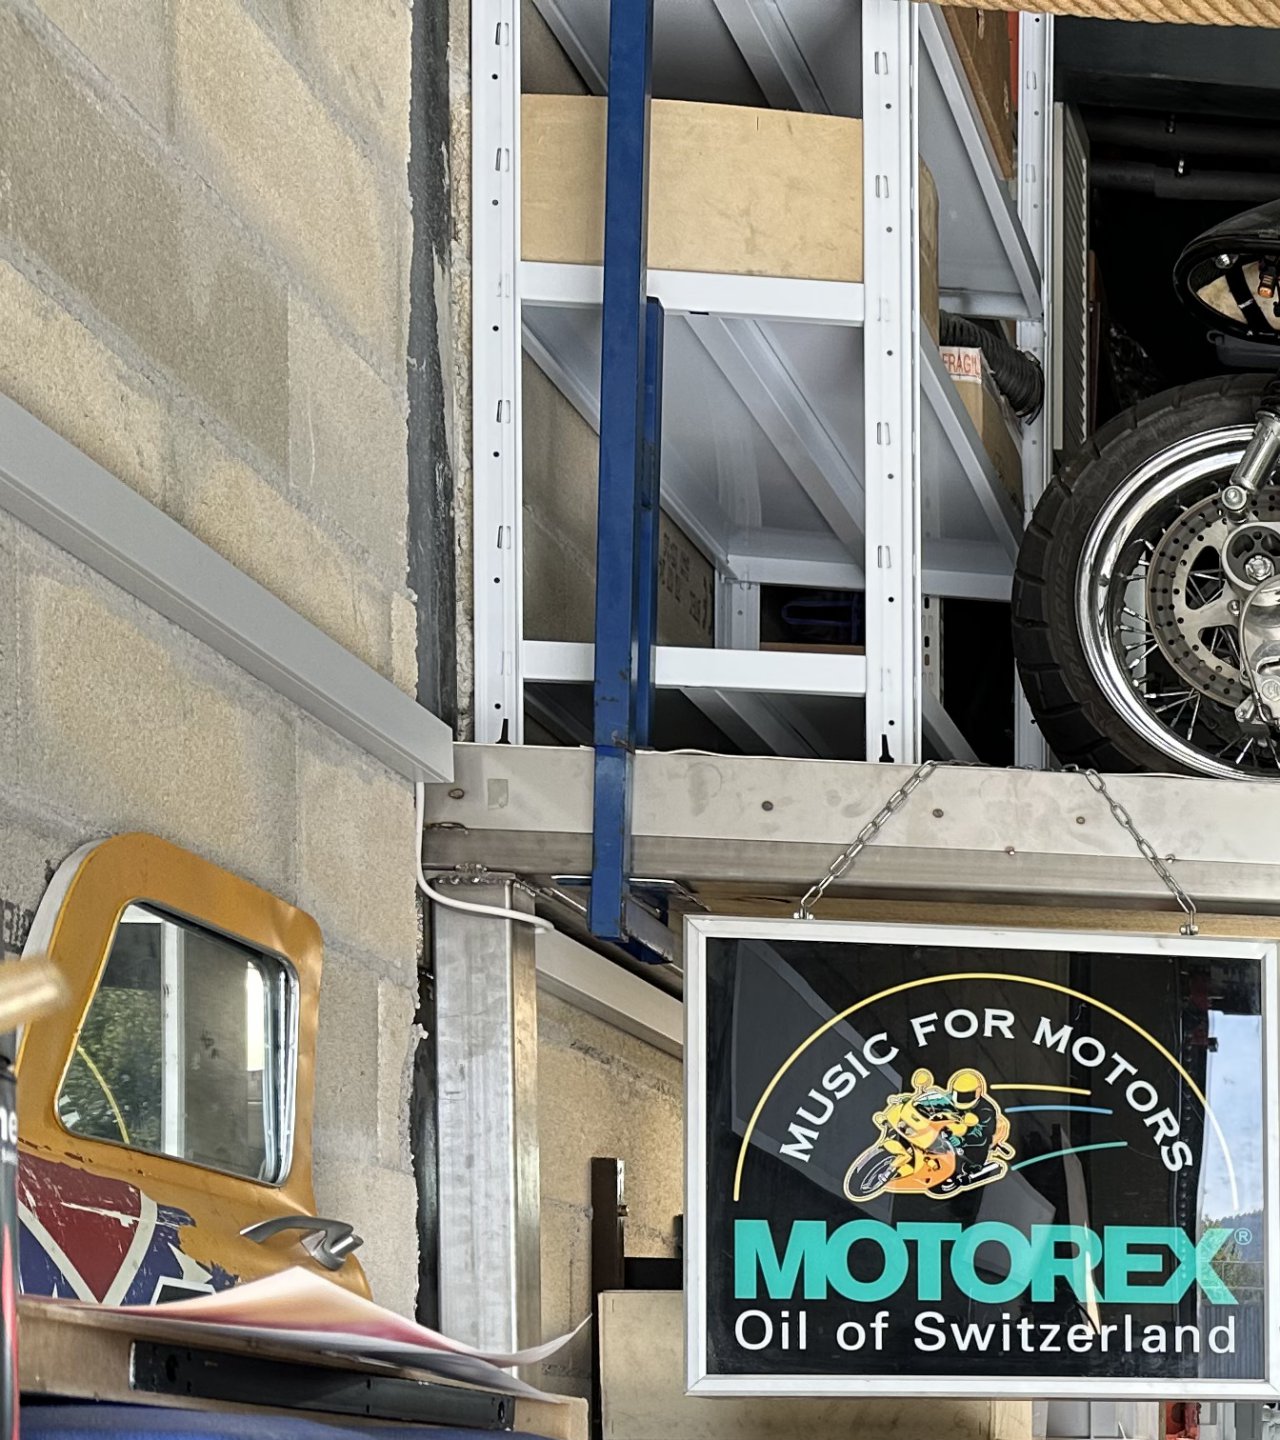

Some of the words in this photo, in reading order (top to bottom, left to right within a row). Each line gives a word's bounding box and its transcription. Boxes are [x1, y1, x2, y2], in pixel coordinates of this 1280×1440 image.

[942, 353, 981, 375] FRAGIL
[779, 1033, 900, 1163] MUSIC
[910, 1008, 1015, 1048] FOR
[1032, 1016, 1193, 1173] MOTORS
[734, 1219, 1239, 1305] MOTOREX
[734, 1310, 808, 1351] Oil
[836, 1311, 889, 1351] of
[914, 1312, 1236, 1354] Switzerland
